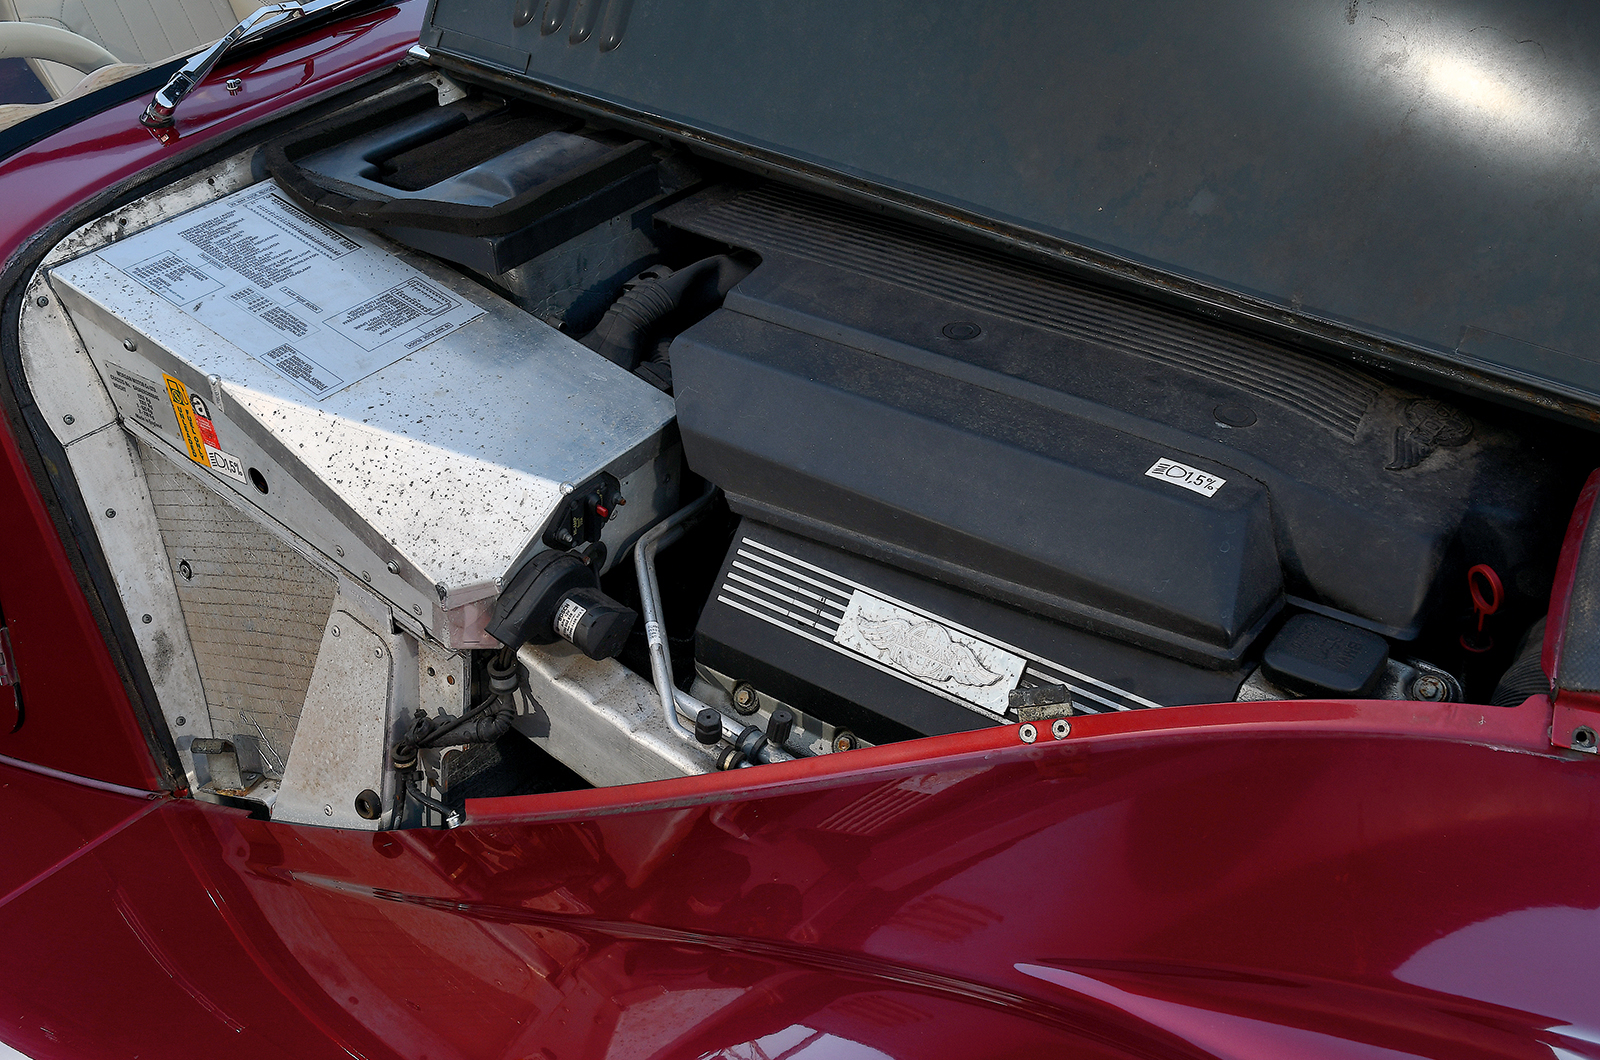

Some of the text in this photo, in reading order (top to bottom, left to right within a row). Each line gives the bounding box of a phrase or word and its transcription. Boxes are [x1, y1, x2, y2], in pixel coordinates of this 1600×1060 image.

[177, 406, 197, 458] UNLEADED
[185, 408, 205, 461] FUEL ONLY
[1184, 471, 1217, 491] 1,5%
[558, 603, 571, 622] BOSCH
